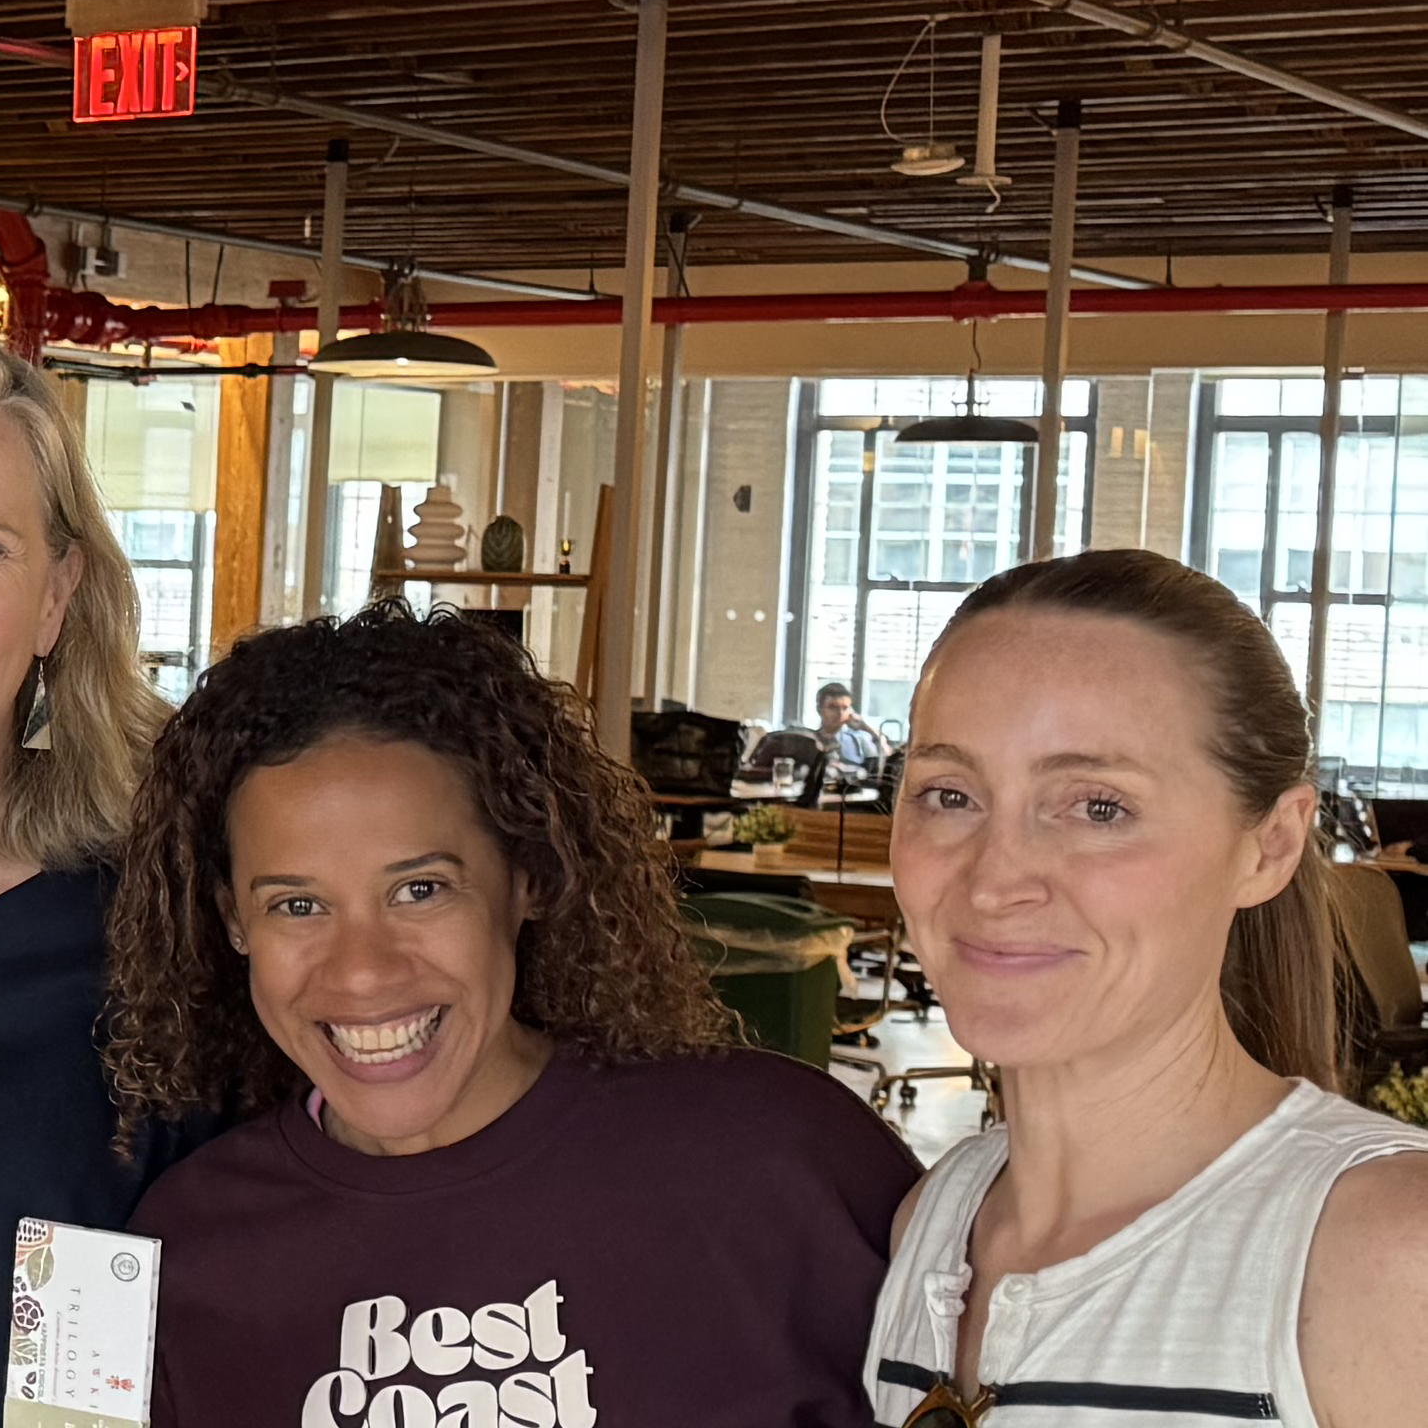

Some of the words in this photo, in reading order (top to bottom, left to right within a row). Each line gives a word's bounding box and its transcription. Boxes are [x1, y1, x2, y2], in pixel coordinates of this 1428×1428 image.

[89, 30, 183, 116] EXIT
[64, 1286, 82, 1398] TRILOGY
[339, 1279, 567, 1381] Best
